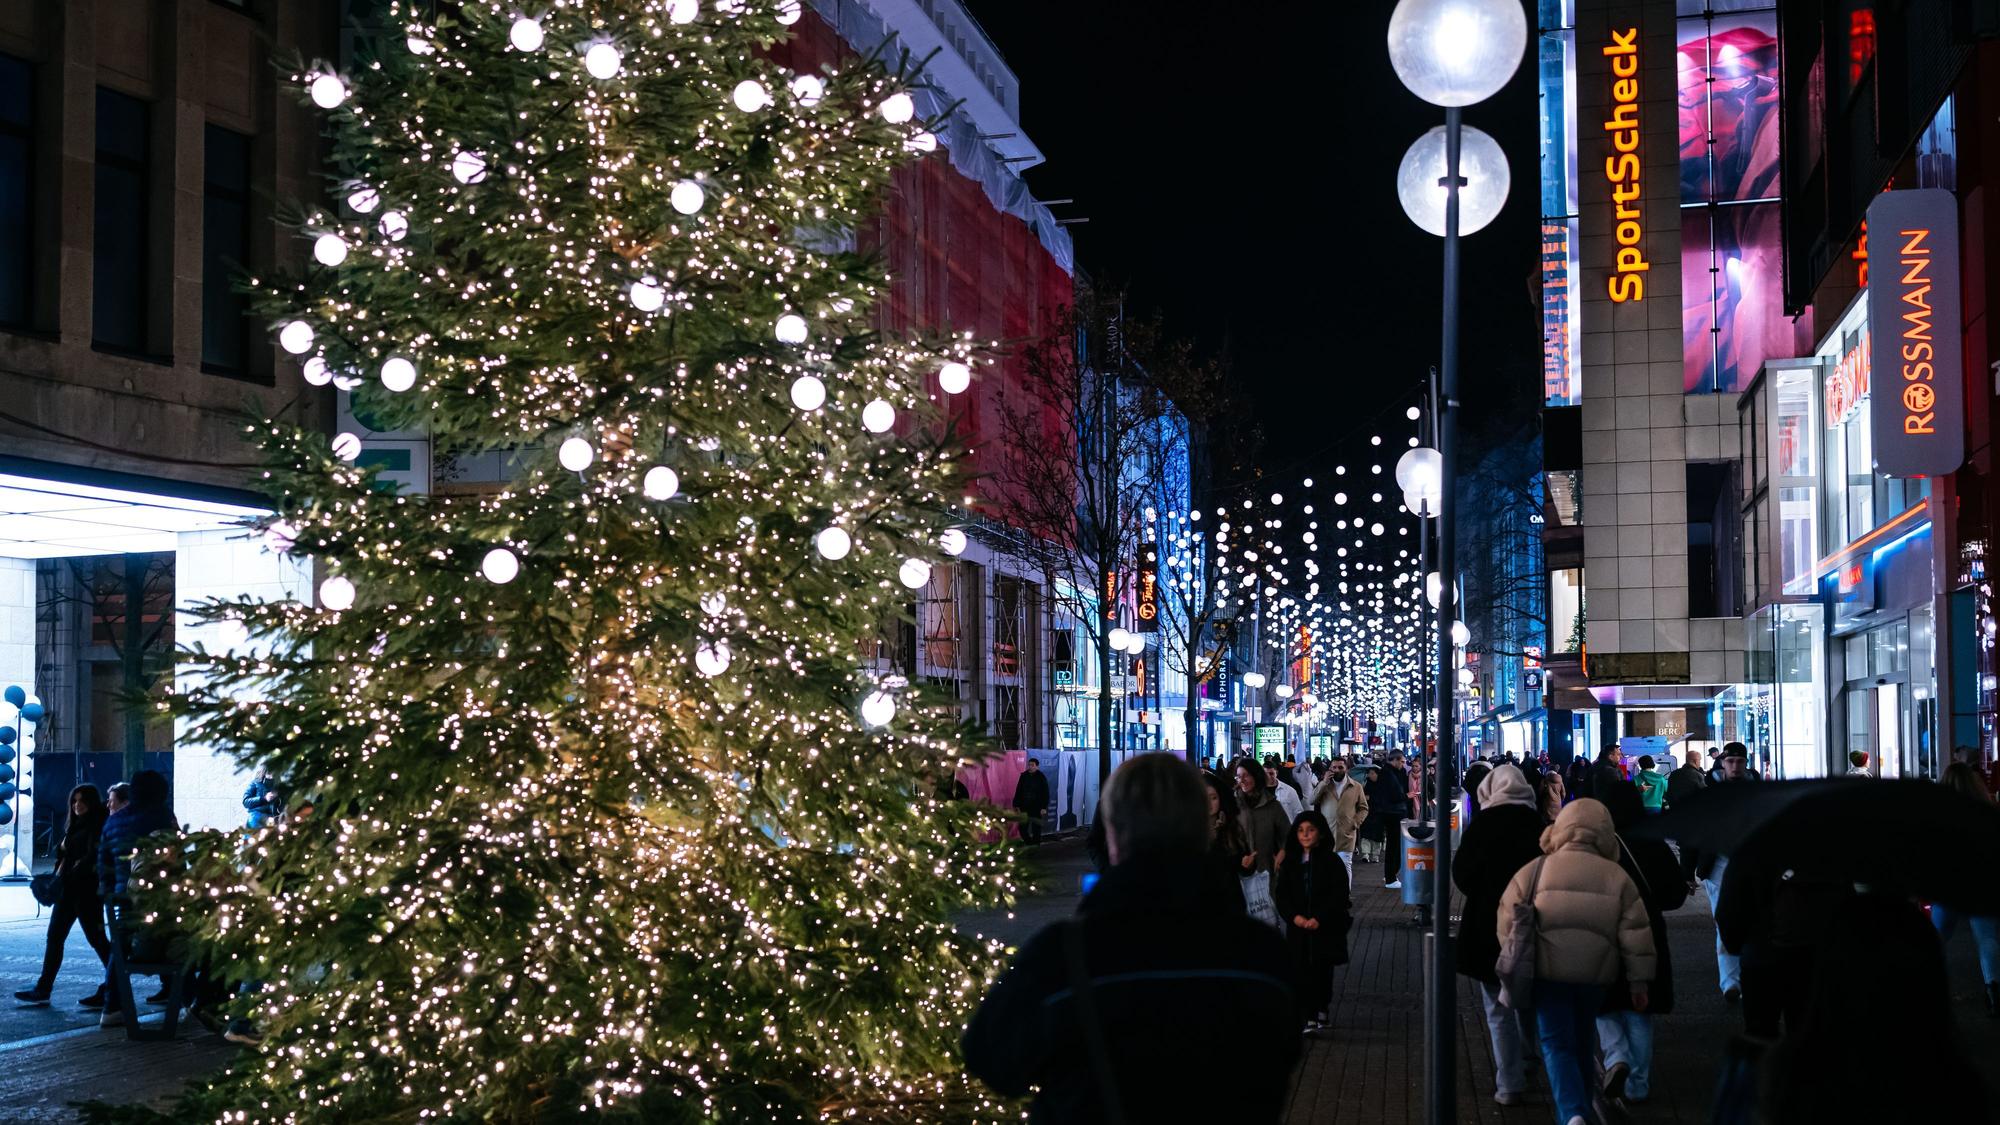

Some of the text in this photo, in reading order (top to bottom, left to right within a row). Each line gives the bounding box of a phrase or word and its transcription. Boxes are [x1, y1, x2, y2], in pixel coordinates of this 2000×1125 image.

[1603, 27, 1649, 303] SportScheck
[1900, 229, 1935, 434] ROSSMANN
[1219, 660, 1227, 703] SEPHORA
